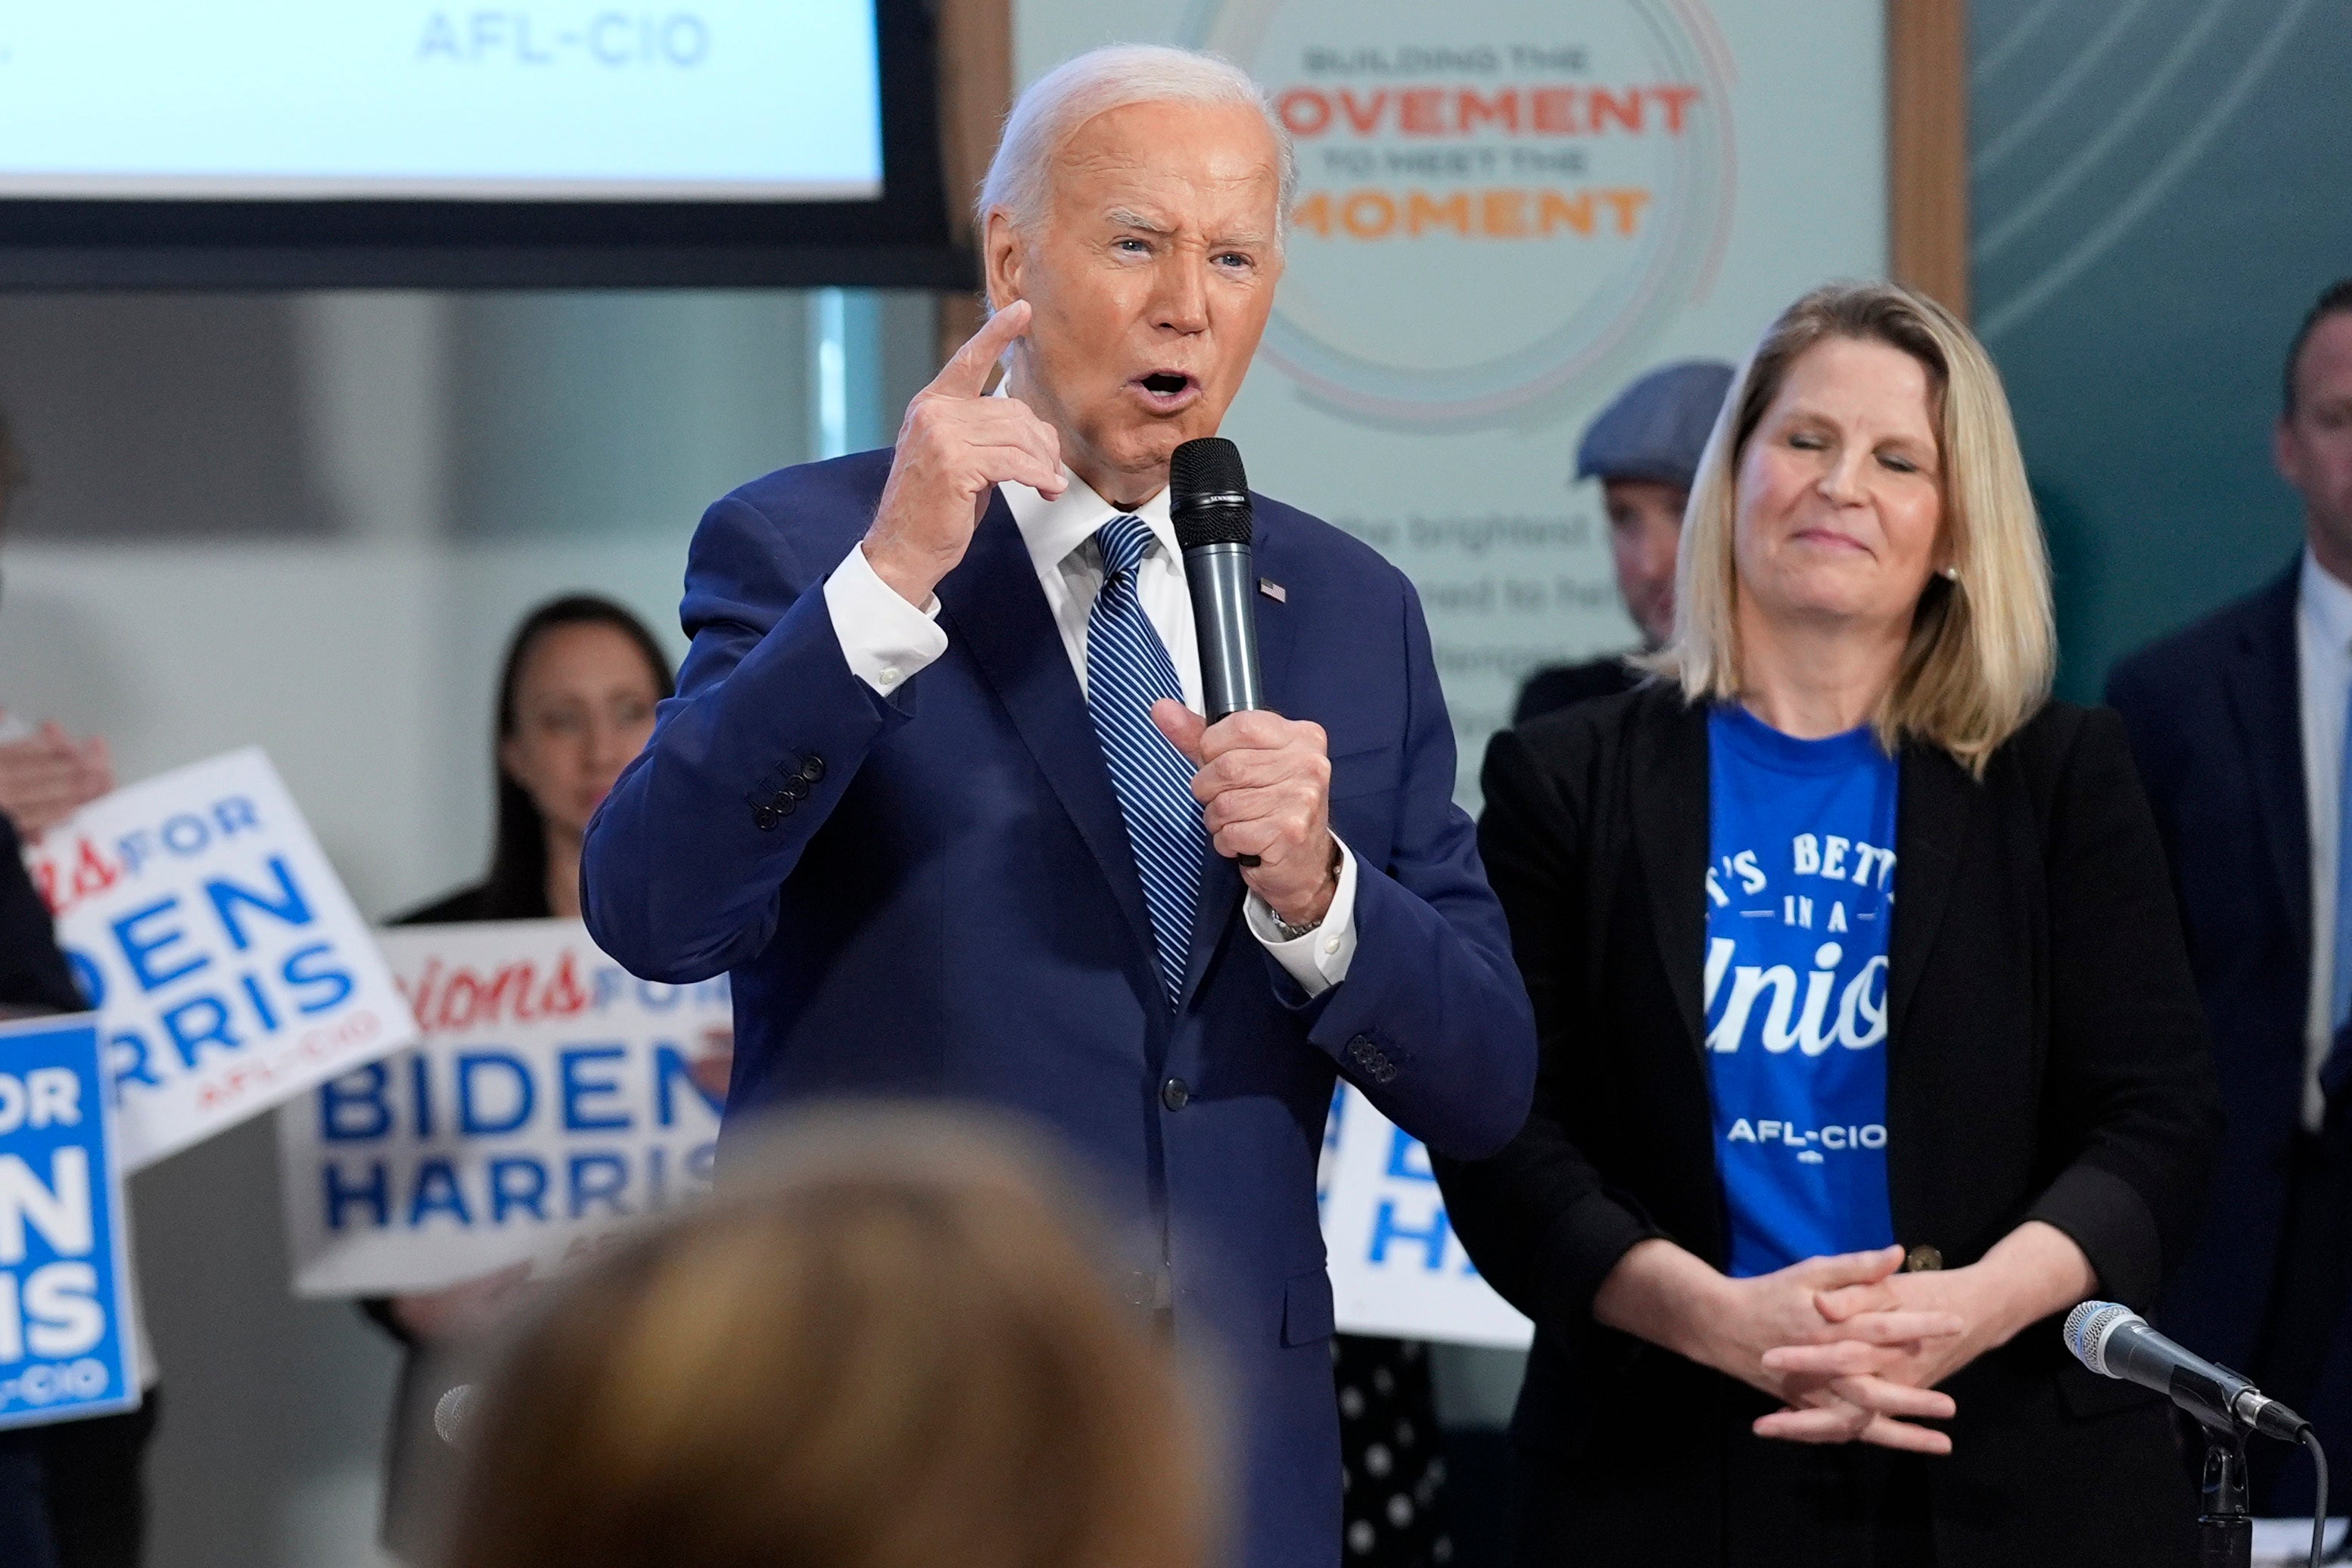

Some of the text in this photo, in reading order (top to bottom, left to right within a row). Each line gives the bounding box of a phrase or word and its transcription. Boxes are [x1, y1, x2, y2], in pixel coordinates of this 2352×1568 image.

[417, 11, 711, 66] AFL-CIO
[1302, 44, 1588, 73] BUILDING THE
[1277, 86, 1700, 136] OVEMENT
[1322, 147, 1586, 178] TO MEET THE
[117, 795, 261, 876] FOR
[67, 853, 316, 1010] DEN
[1784, 894, 1848, 933] IN A
[112, 941, 356, 1091] RRIS
[394, 944, 587, 1035] ions
[1704, 937, 1888, 1056] nio
[1727, 1118, 1887, 1150] AFL-CIO
